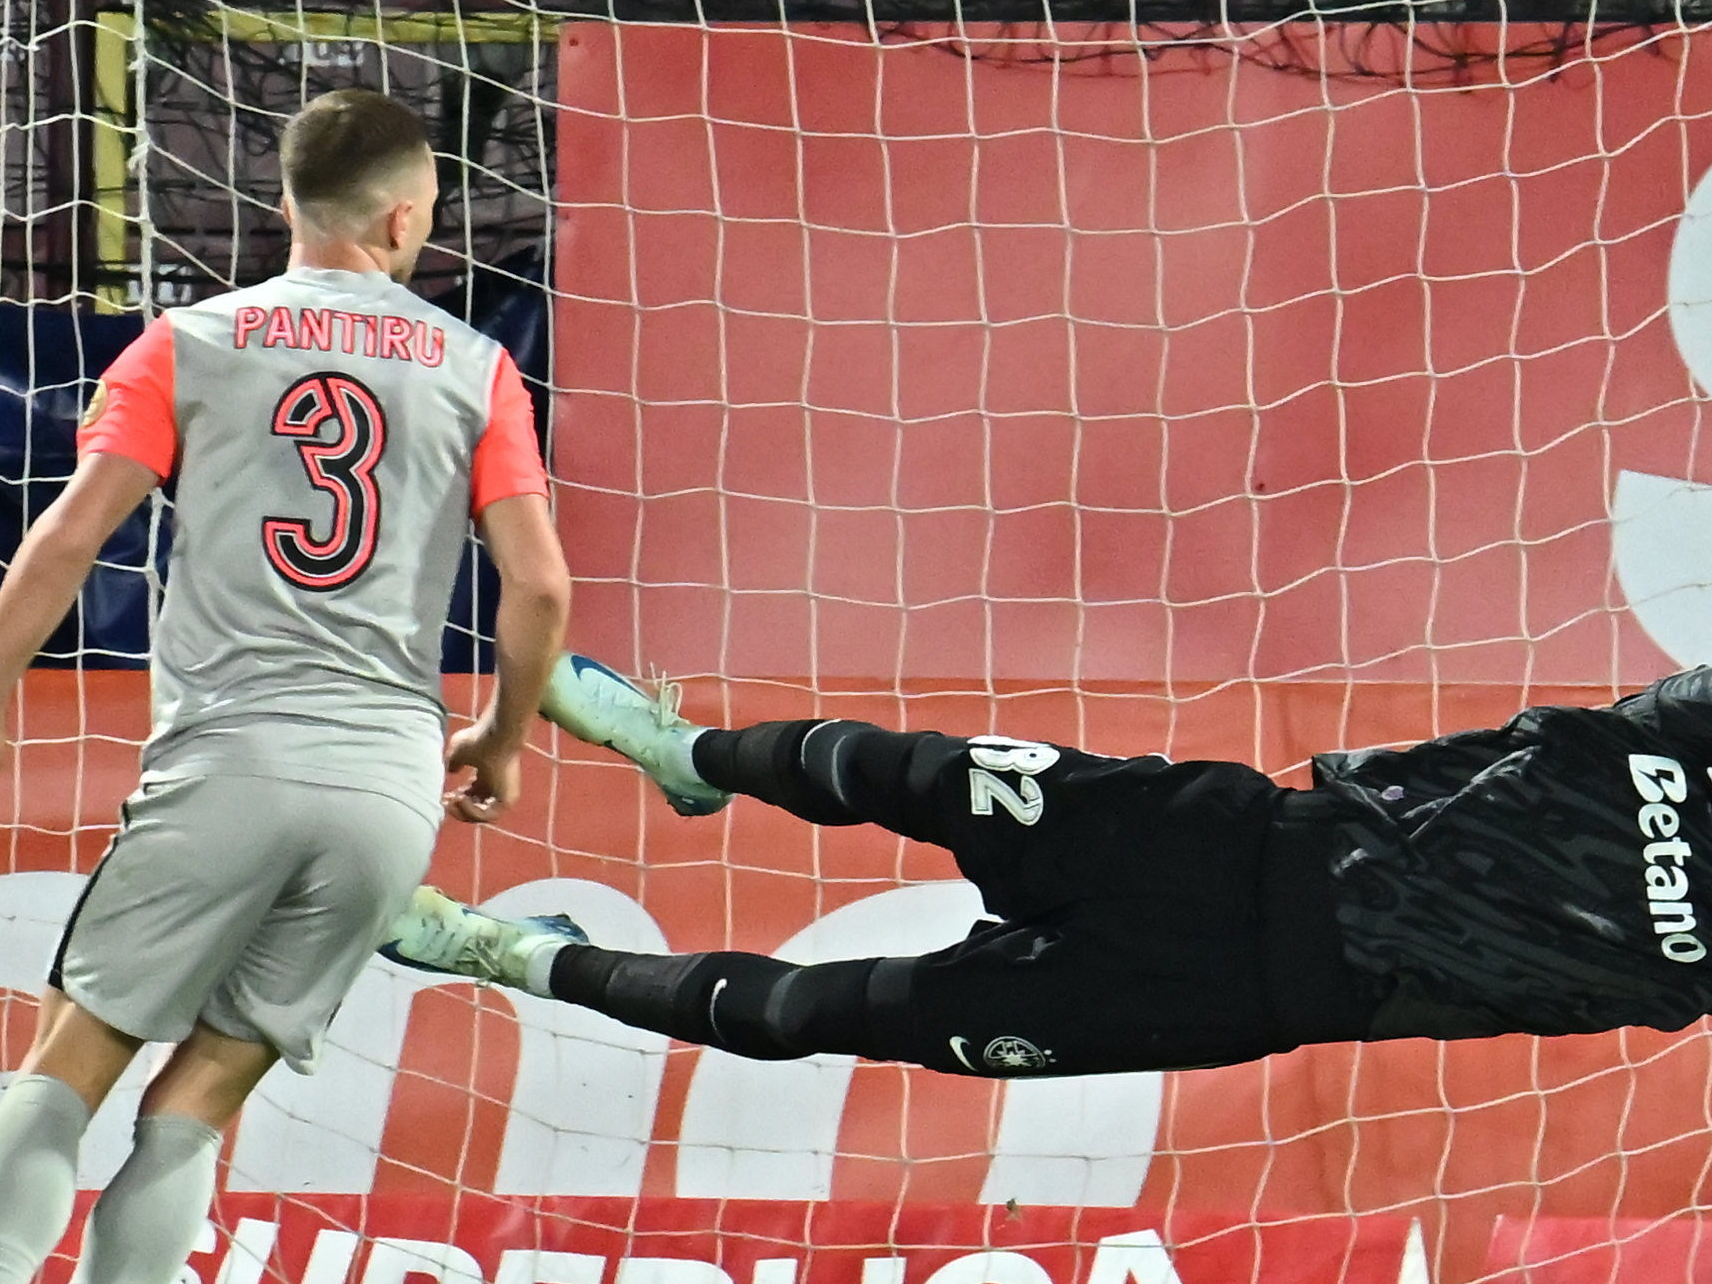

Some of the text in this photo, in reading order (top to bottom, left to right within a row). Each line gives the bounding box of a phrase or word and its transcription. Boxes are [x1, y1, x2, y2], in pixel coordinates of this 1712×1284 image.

[234, 306, 445, 368] PANTIRU
[263, 371, 388, 593] 3
[1627, 752, 1708, 964] Betano
